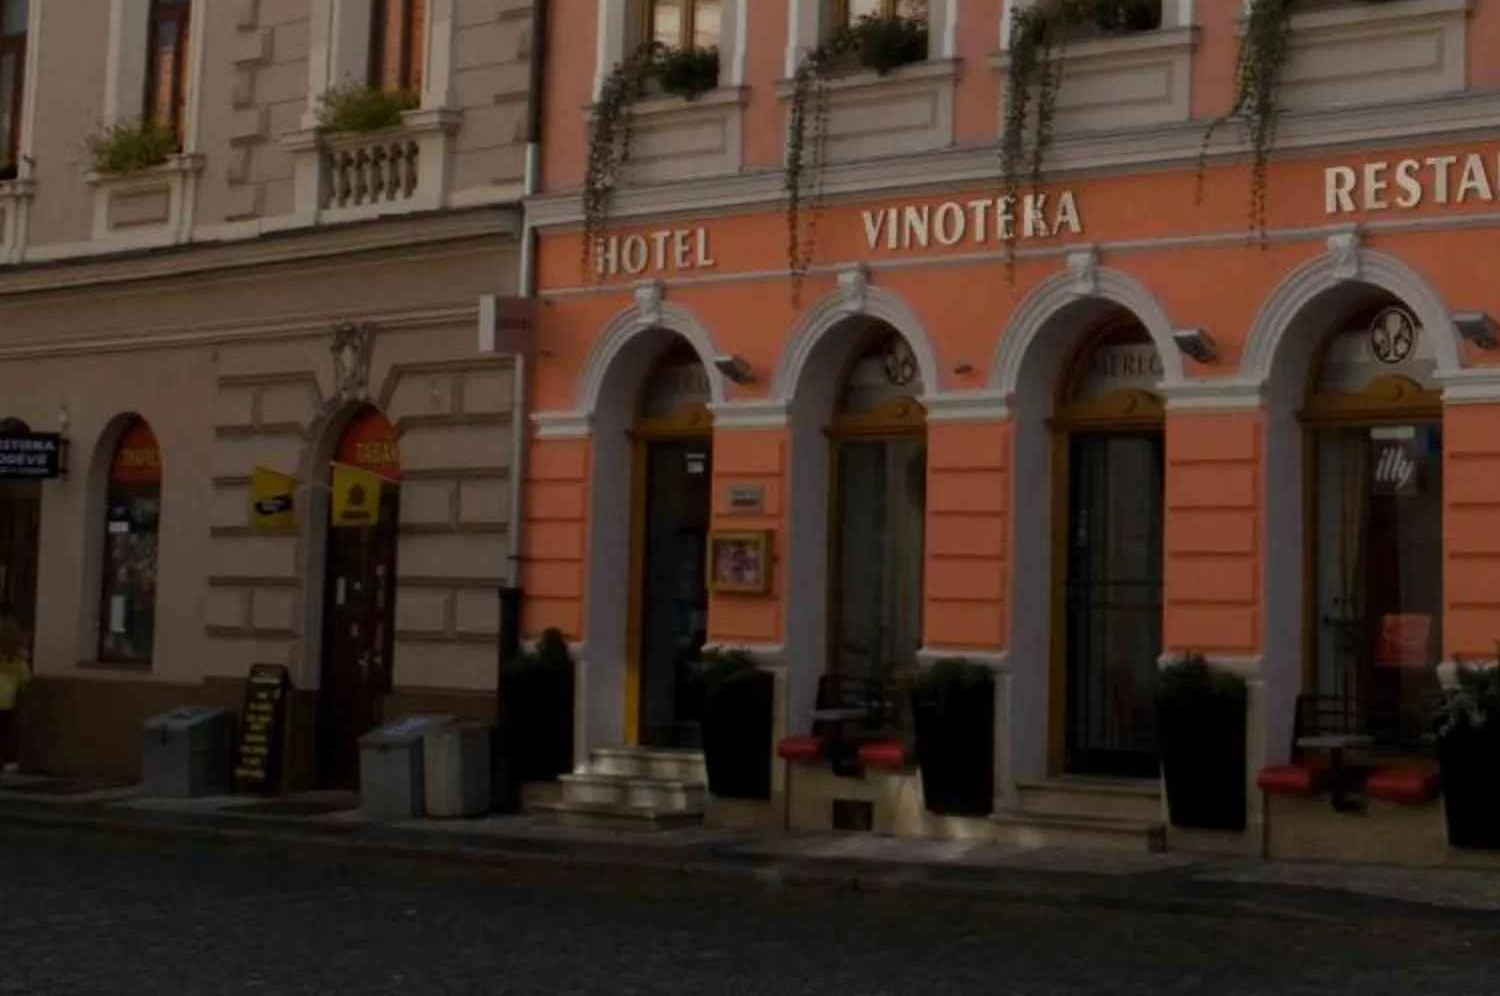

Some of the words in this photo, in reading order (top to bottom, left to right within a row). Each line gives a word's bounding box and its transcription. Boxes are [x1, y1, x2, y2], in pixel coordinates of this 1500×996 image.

[861, 190, 1082, 249] VINOTEKA
[594, 226, 715, 275] HOTEL
[1374, 447, 1415, 490] illy
